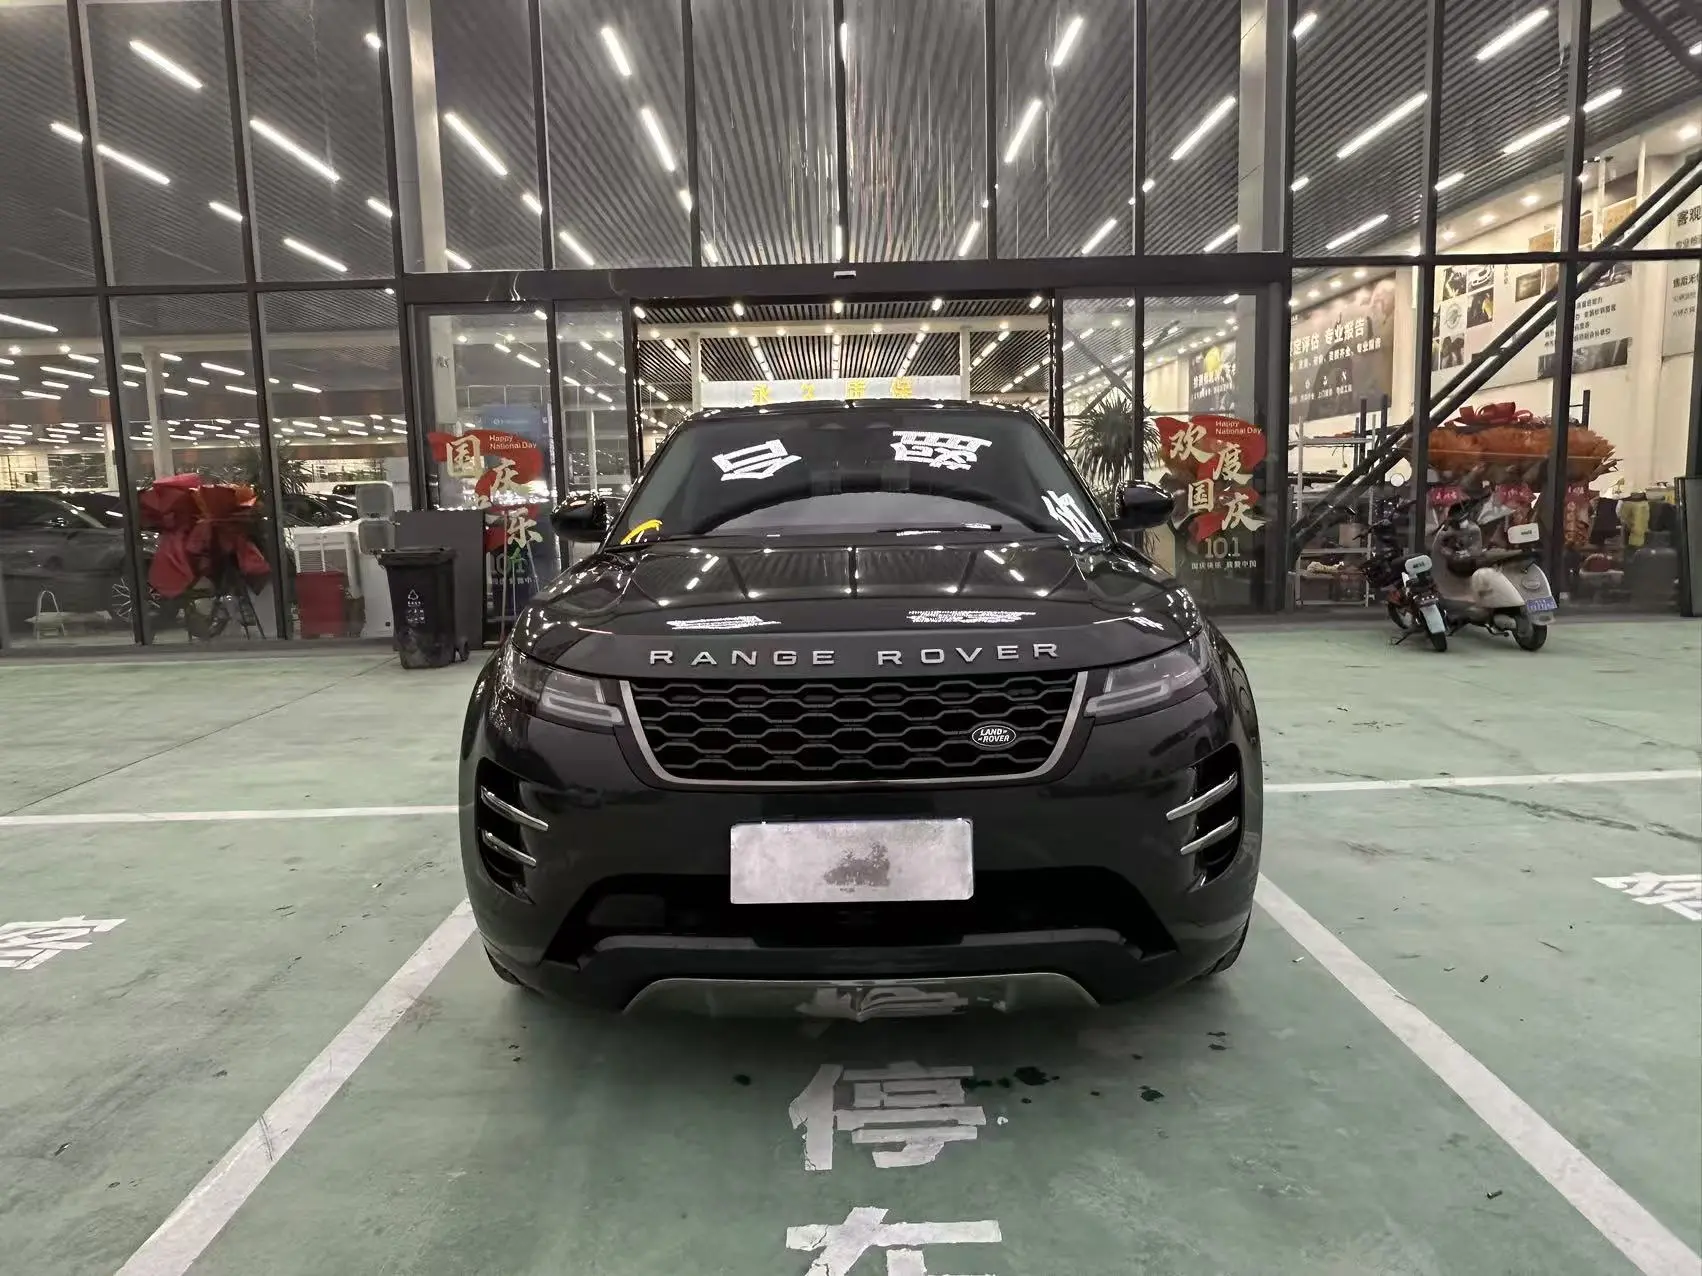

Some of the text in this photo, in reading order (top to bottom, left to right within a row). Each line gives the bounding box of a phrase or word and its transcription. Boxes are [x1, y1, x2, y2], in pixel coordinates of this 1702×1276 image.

[1291, 332, 1320, 356] 定评估
[1325, 317, 1365, 345] 专业报告
[1215, 420, 1239, 428] Happy
[1215, 427, 1262, 436] National Day
[489, 434, 513, 443] Happy
[489, 441, 537, 450] National Day
[1205, 537, 1241, 559] 10.1
[649, 642, 1059, 667] RANGE ROVER
[980, 728, 1003, 736] LAND
[982, 734, 1010, 743] ROVER
